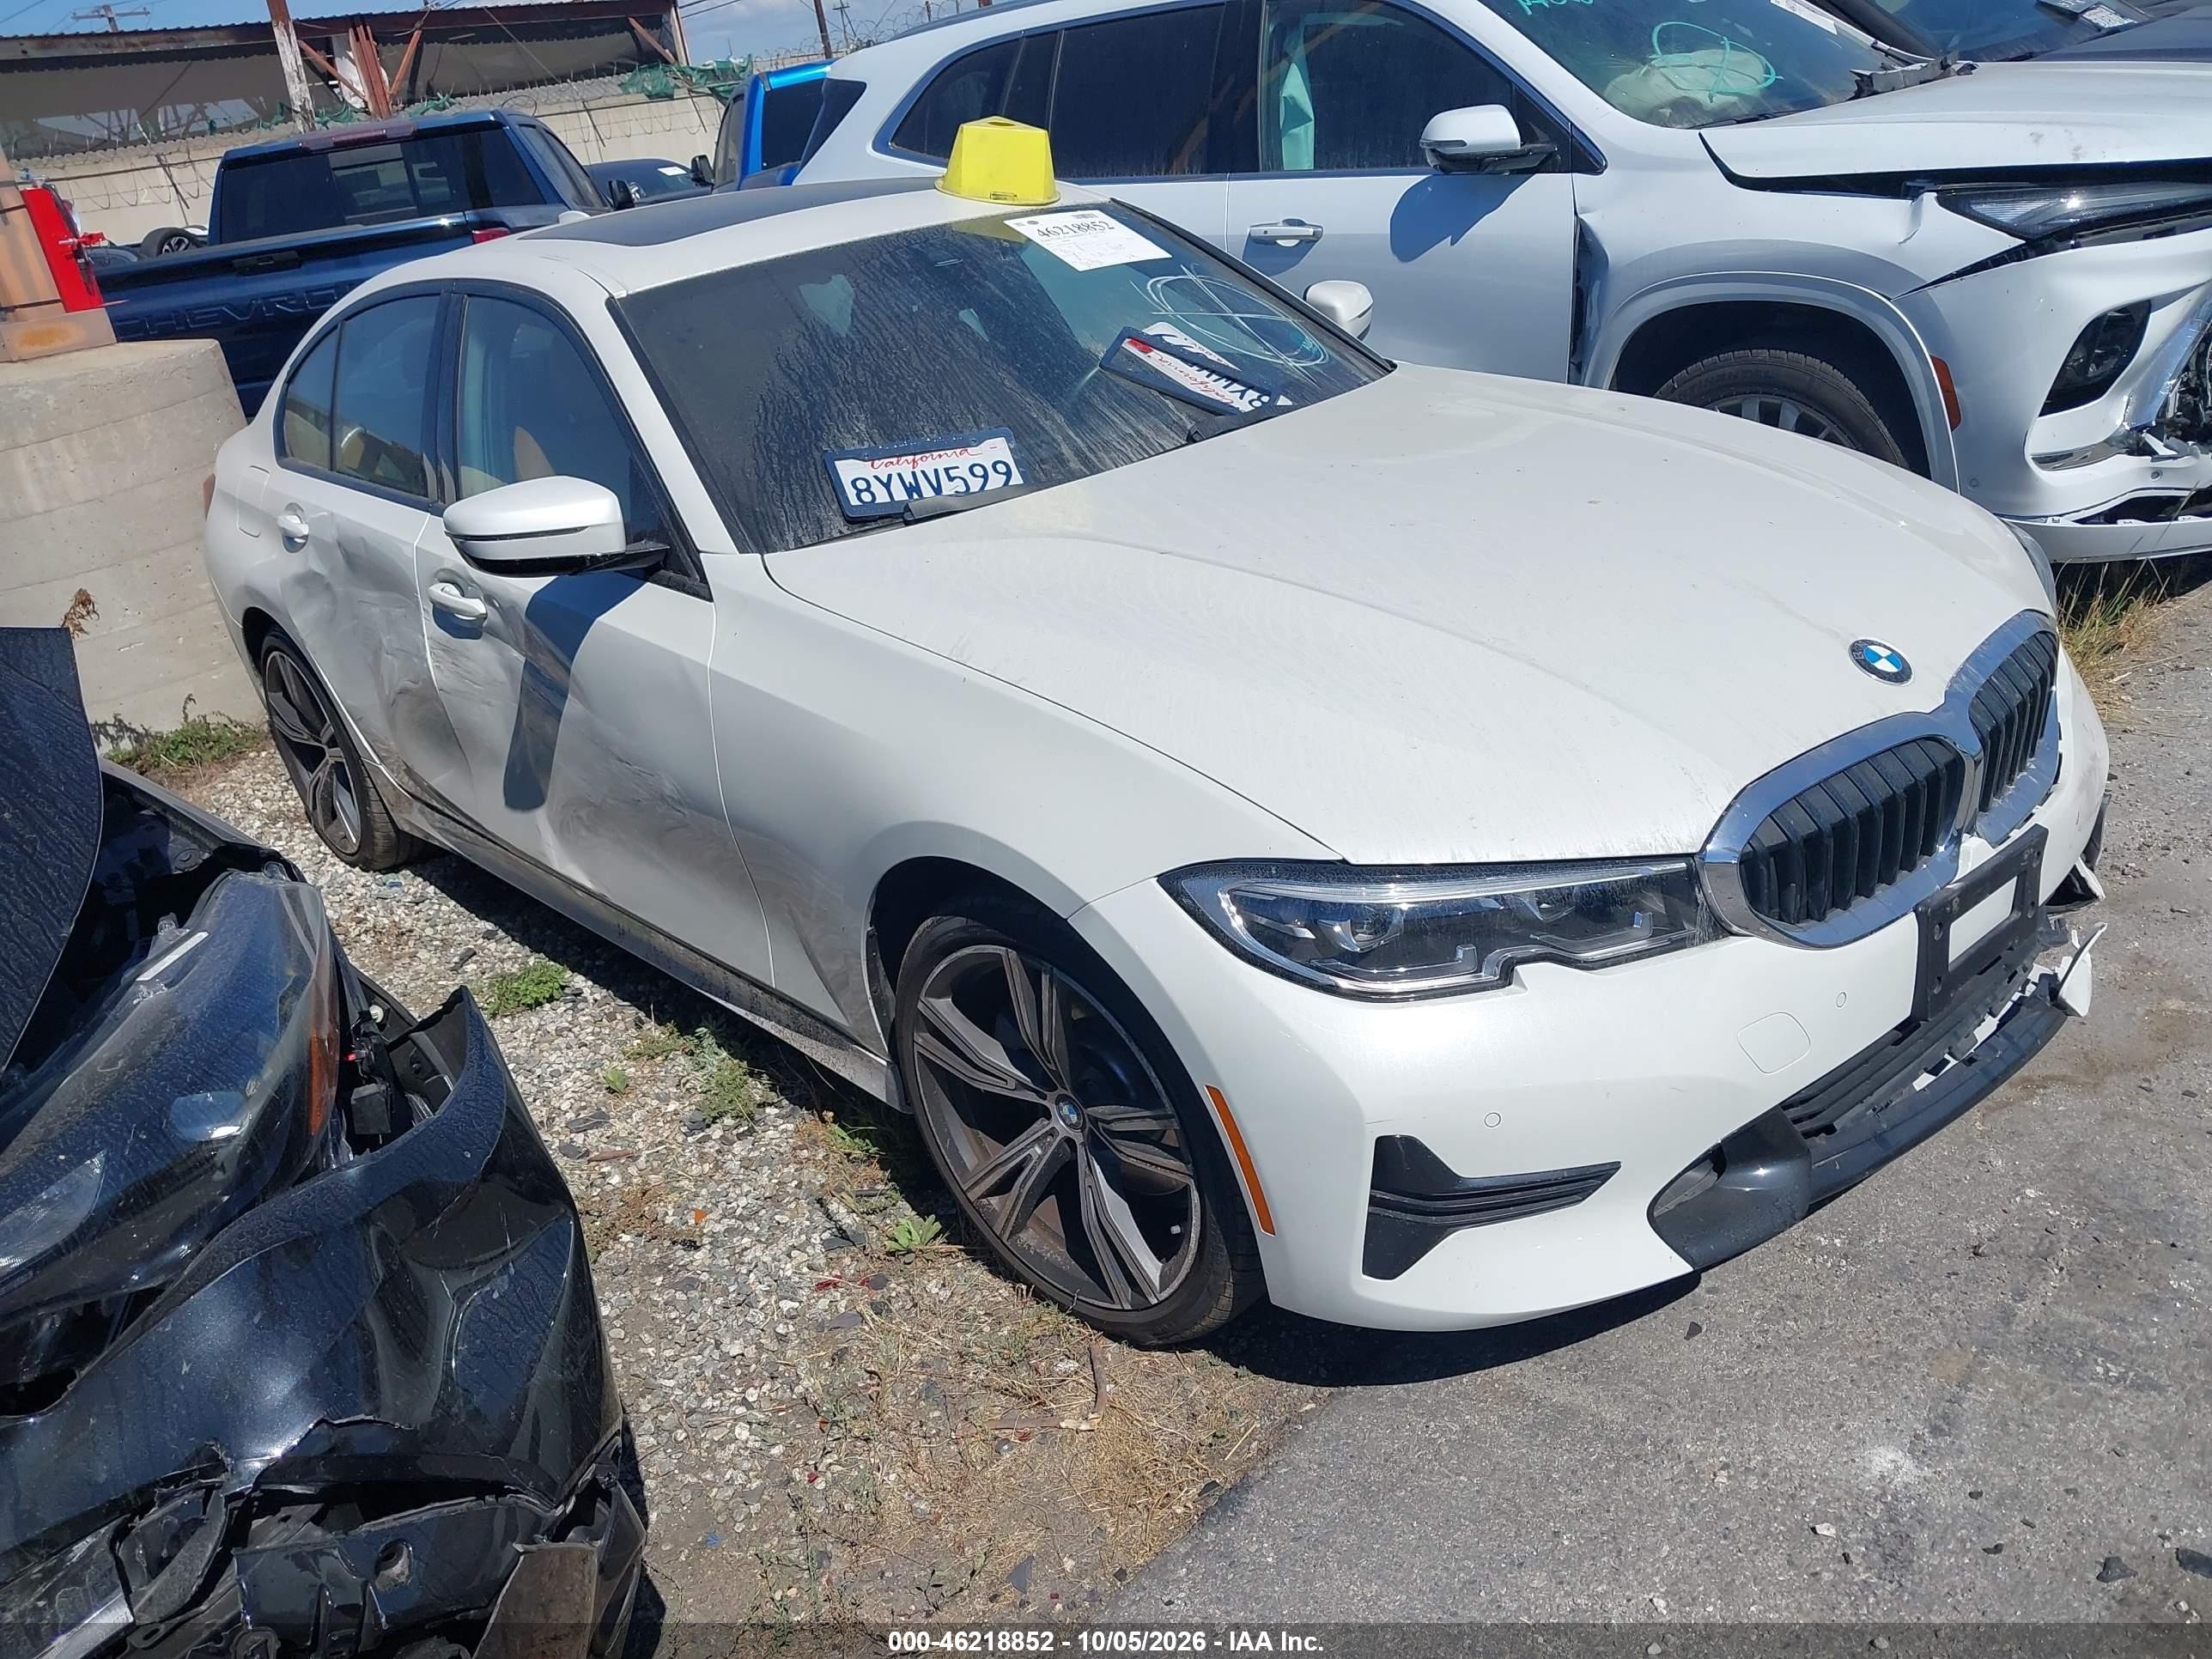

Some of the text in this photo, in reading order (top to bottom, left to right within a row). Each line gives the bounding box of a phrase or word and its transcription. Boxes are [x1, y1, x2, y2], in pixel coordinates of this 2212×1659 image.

[1036, 220, 1116, 239] 46218852
[115, 288, 340, 339] CHEVRO
[870, 447, 982, 470] California
[850, 459, 1012, 505] 8YWV599
